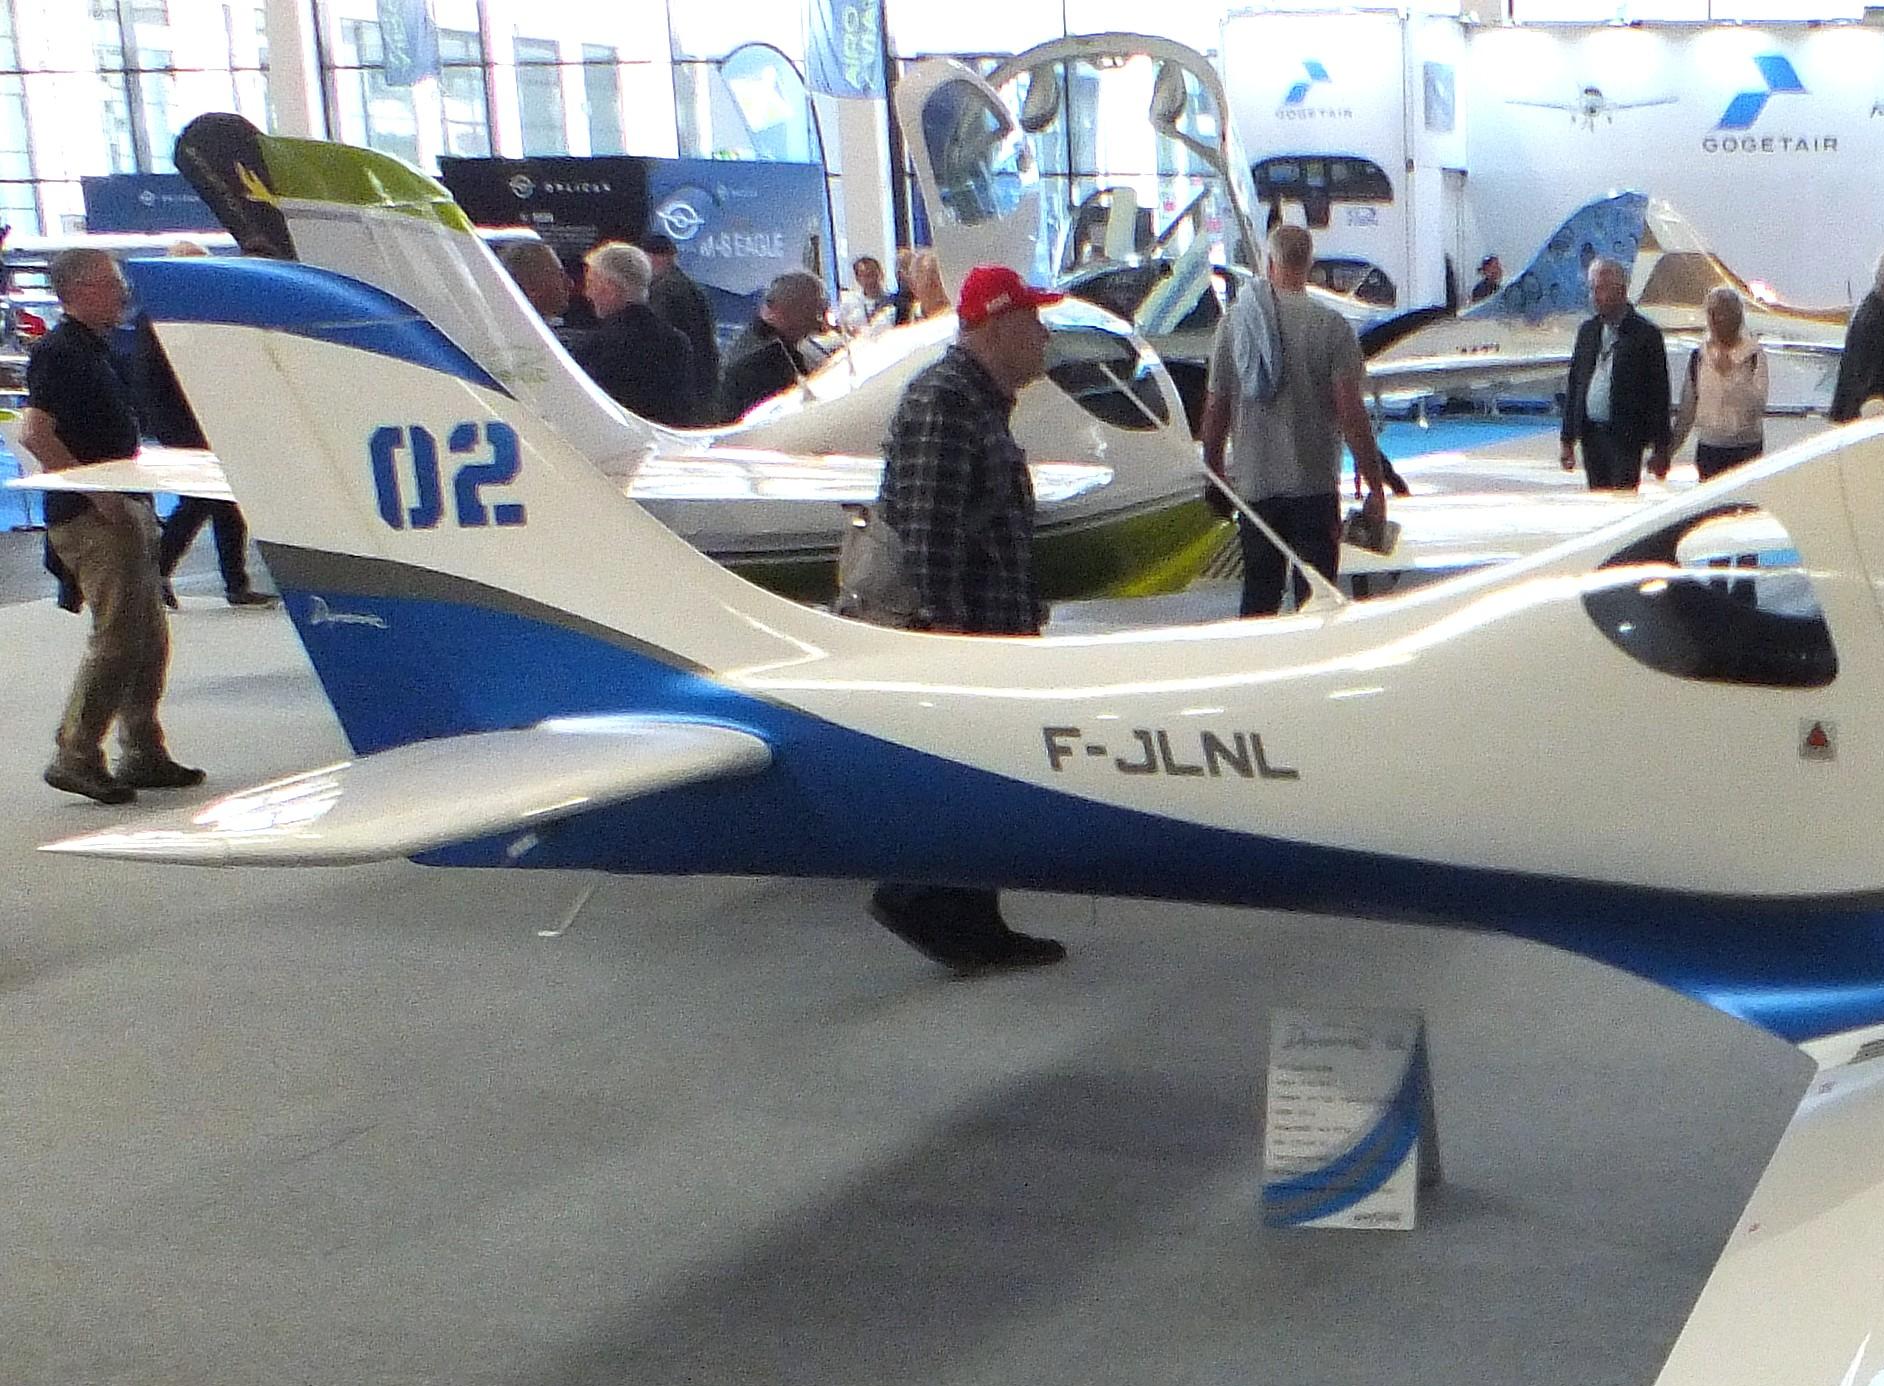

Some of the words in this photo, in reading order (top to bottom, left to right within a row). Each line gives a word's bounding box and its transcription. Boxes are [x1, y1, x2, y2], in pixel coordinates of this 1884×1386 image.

[1702, 137, 1838, 153] GOGETAIR
[369, 420, 528, 531] 02
[1042, 726, 1300, 780] F-JLNL
